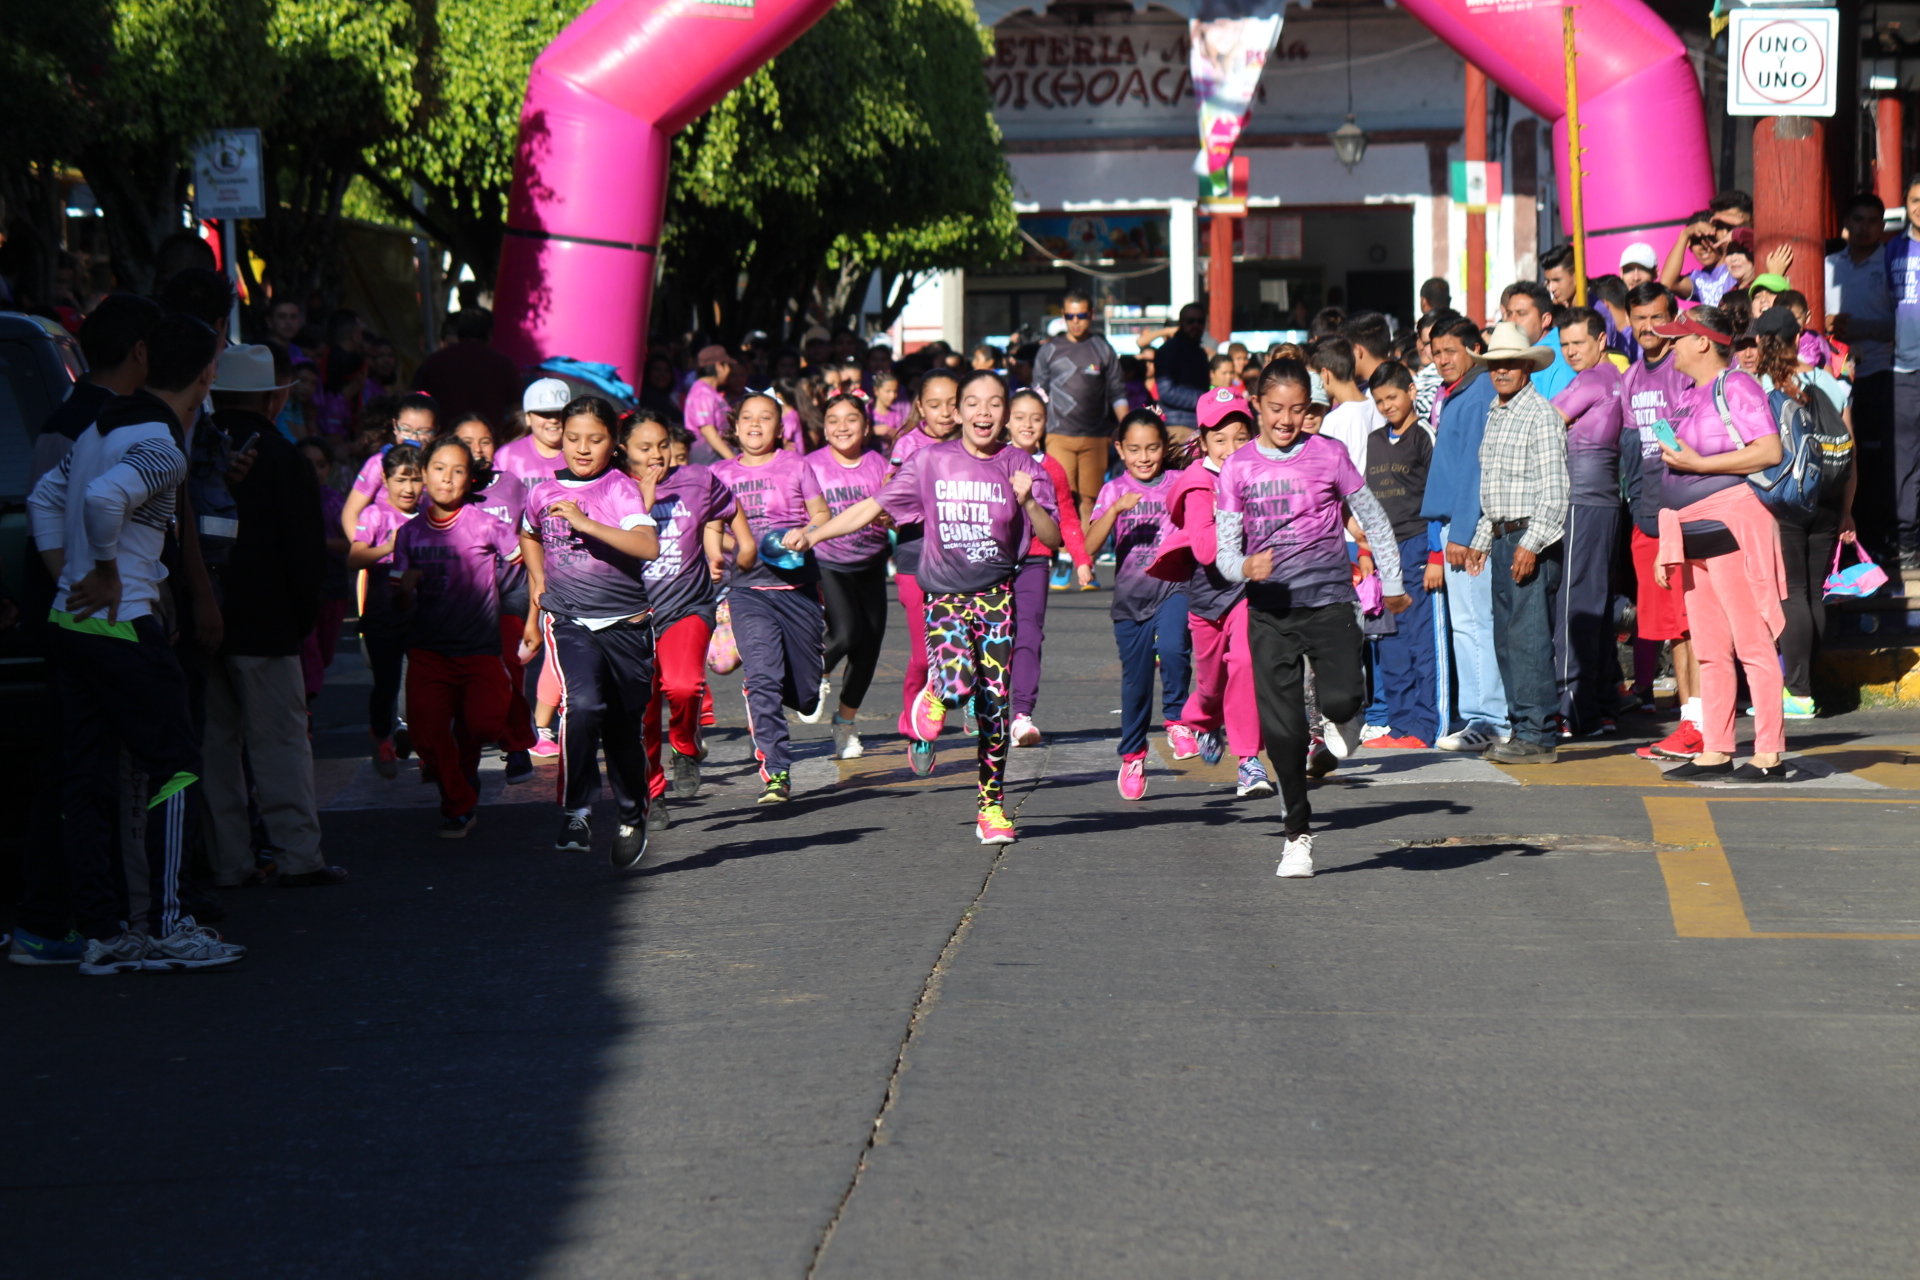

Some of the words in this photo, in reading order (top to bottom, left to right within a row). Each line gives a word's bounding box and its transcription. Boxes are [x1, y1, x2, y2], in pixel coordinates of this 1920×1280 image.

[1759, 36, 1808, 54] UNO
[1776, 55, 1786, 70] Y
[1758, 71, 1807, 89] UNO
[935, 480, 1007, 506] CAMINA,
[936, 502, 994, 526] TROTA,
[939, 522, 992, 543] CORRE
